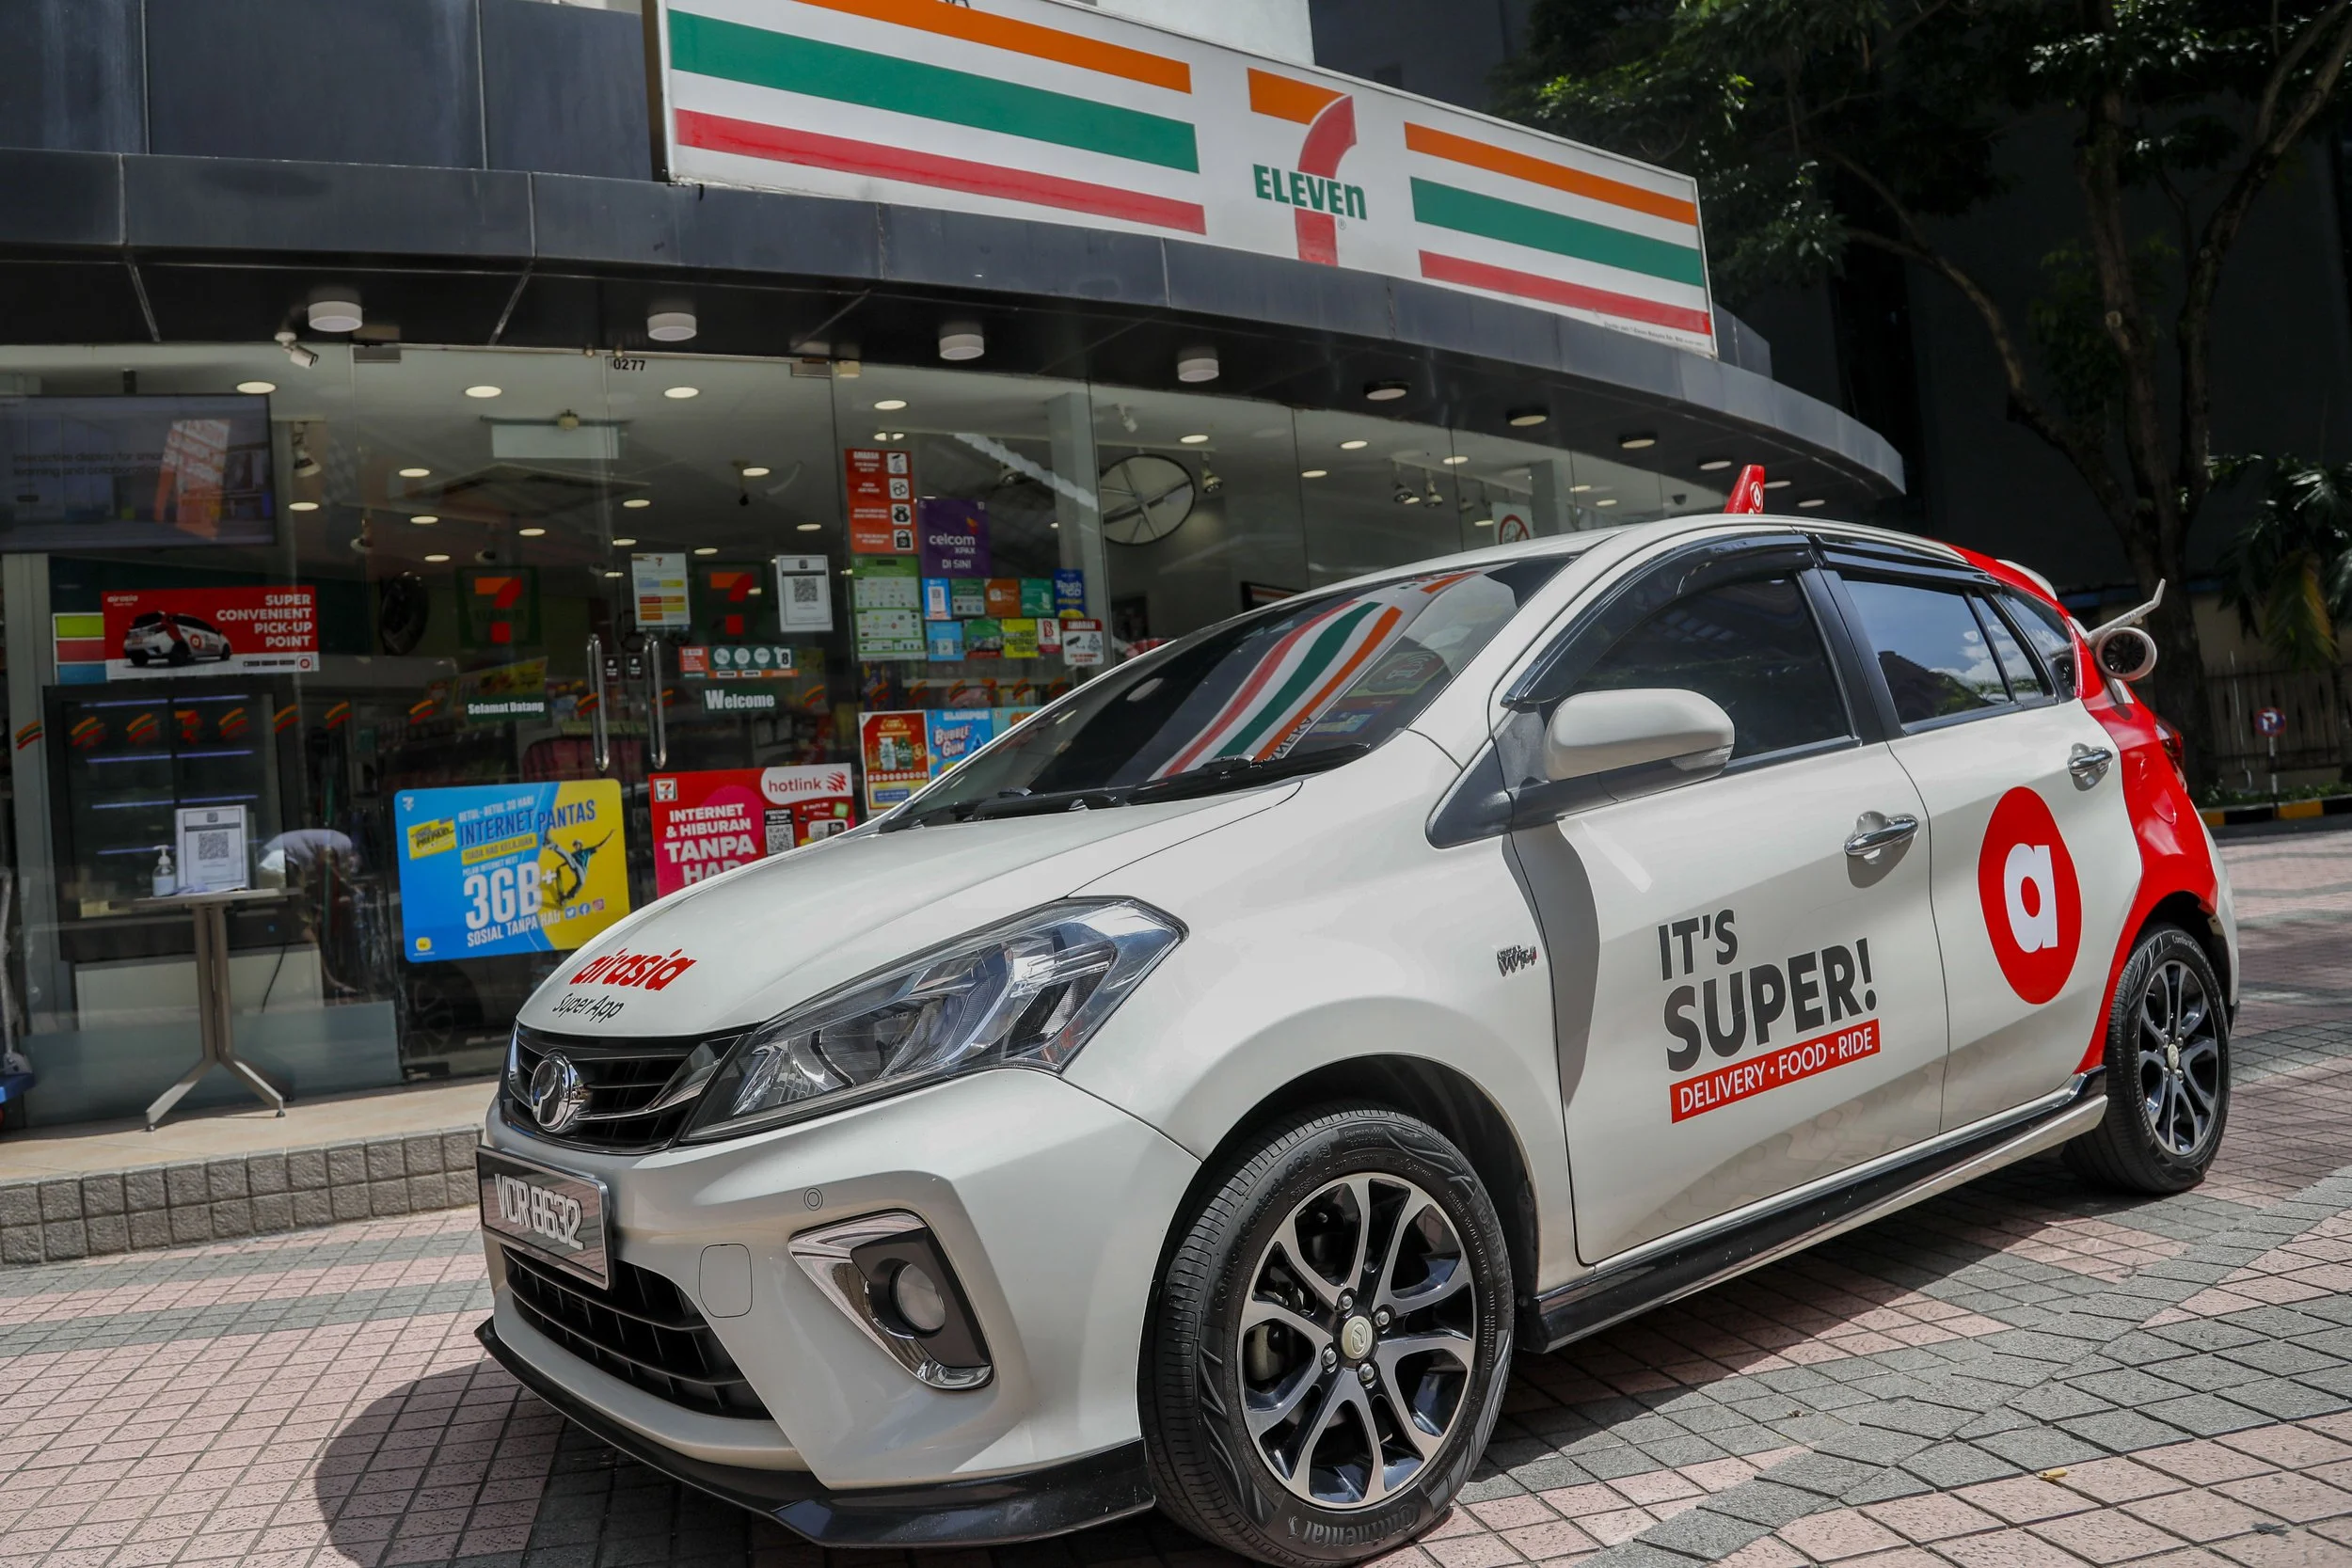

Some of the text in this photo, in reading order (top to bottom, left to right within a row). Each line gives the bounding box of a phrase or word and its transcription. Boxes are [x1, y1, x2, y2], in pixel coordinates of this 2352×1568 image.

[613, 357, 645, 371] 0277
[929, 533, 976, 546] celcom
[942, 559, 972, 569] DI SINI
[264, 594, 311, 606] SUPER
[215, 607, 312, 622] CONVENIENT
[254, 621, 313, 635] PICK-UP
[264, 635, 311, 648] POINT
[468, 701, 545, 715] Selamat Datang
[705, 689, 775, 709] Welcome
[769, 777, 821, 793] hotlink
[669, 803, 745, 823] INTERNET
[459, 800, 596, 847] INTERNET PANTAS
[666, 818, 752, 838] & HIBURAN
[663, 833, 756, 863] TANPA
[2004, 842, 2058, 953] a
[467, 927, 503, 947] SOSIAL
[506, 916, 539, 937] TANPA
[1658, 909, 1739, 982] IT'S
[569, 948, 698, 991] airasia
[552, 993, 624, 1023] Super App
[1662, 937, 1878, 1073] SUPER!
[1680, 1026, 1873, 1114] DELIVERY FOOD RIDE
